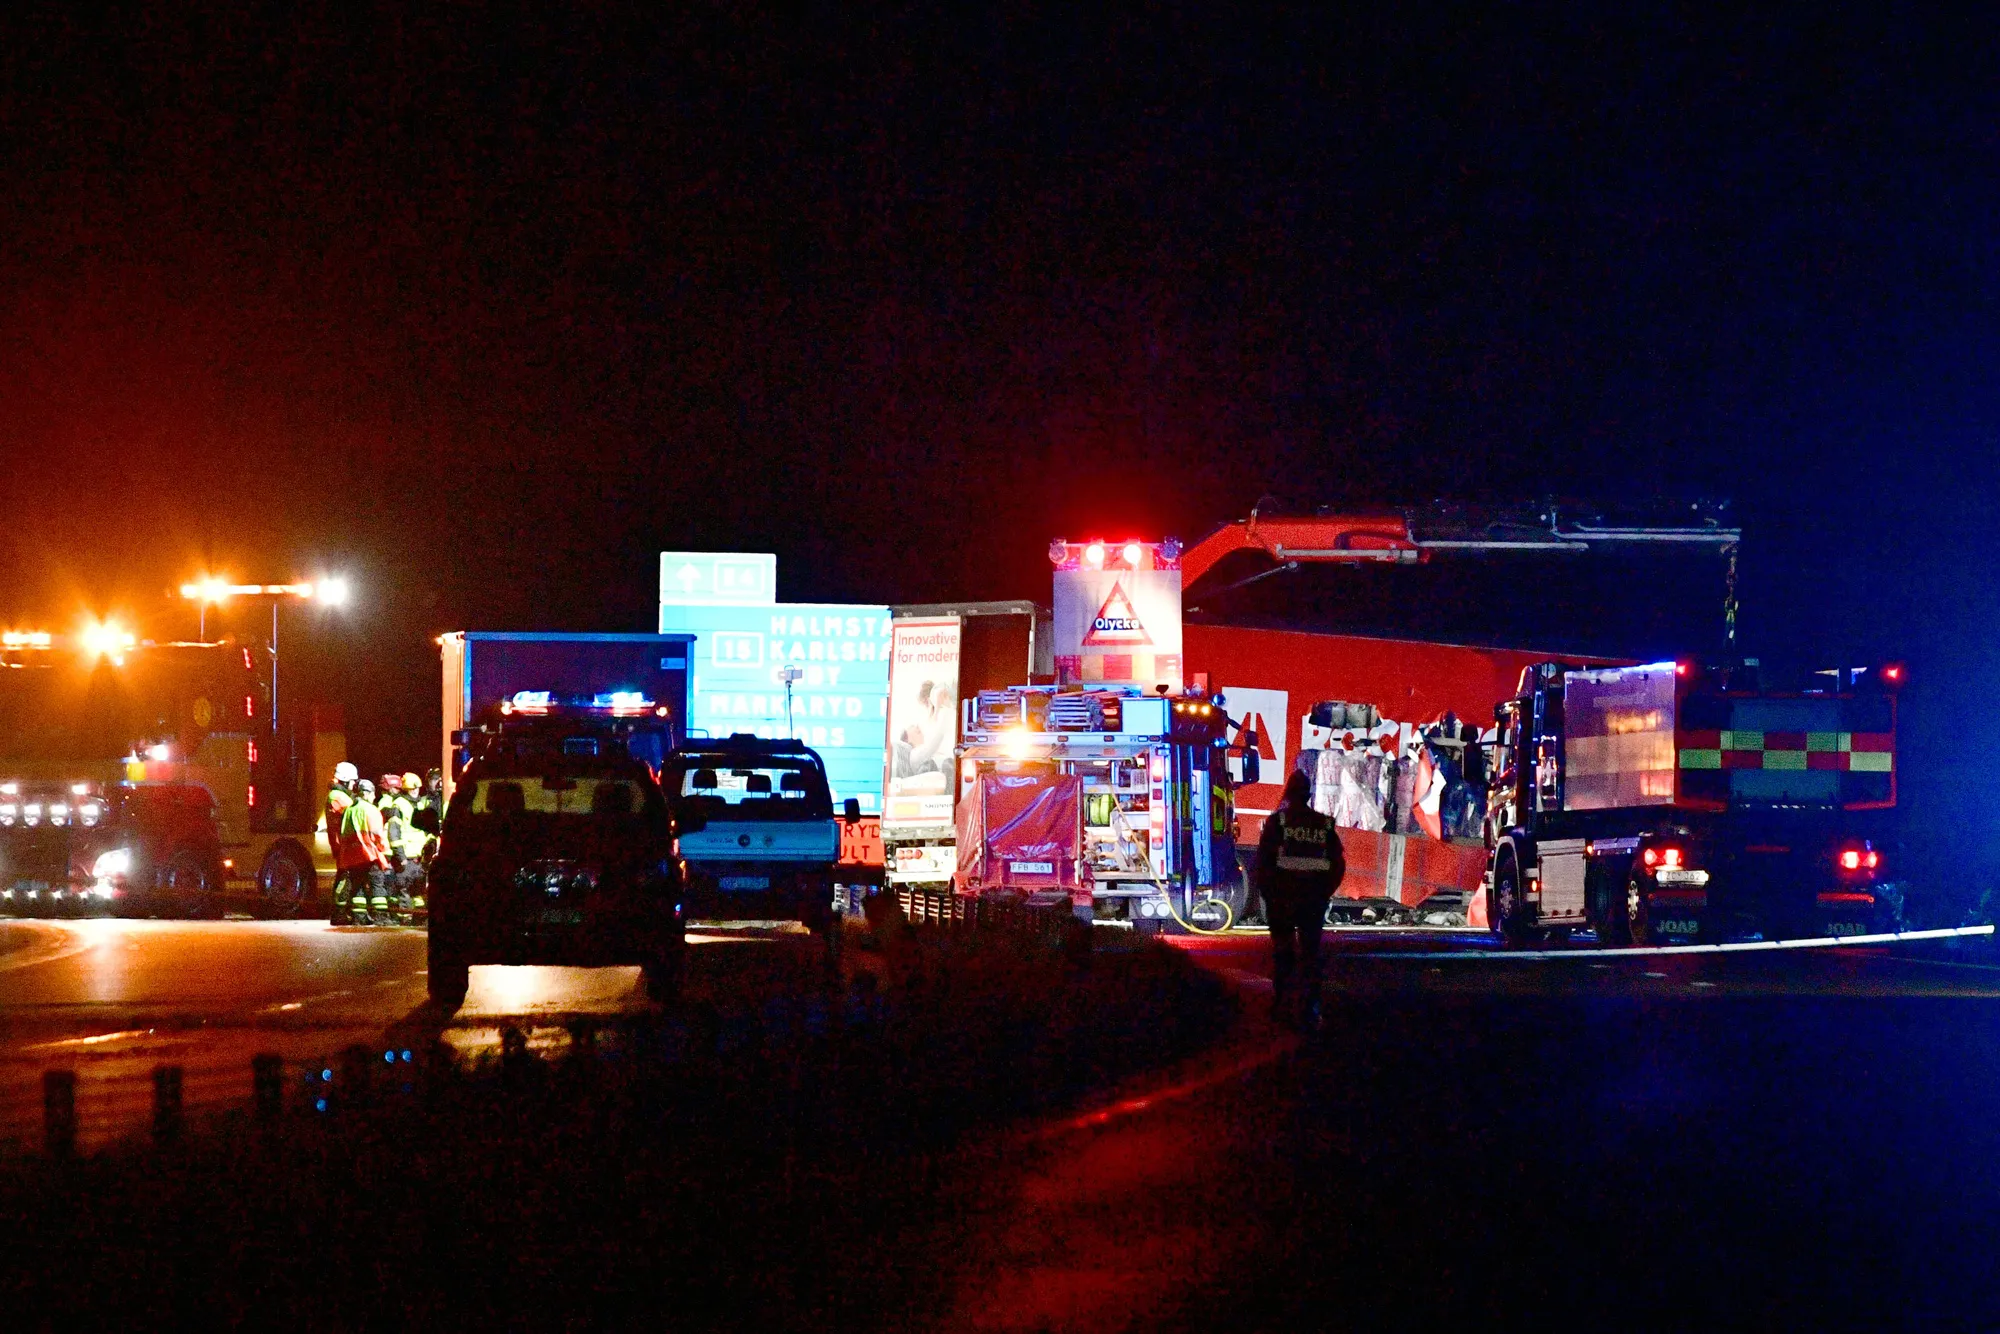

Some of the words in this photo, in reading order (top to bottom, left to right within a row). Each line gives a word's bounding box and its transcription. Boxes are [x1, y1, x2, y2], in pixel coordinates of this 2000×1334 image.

[1095, 617, 1140, 632] Olycka
[898, 631, 957, 646] Innovative
[898, 650, 914, 664] for
[770, 665, 842, 687] OBY
[709, 695, 863, 718] MARKARYD
[1283, 827, 1327, 844] POLIS
